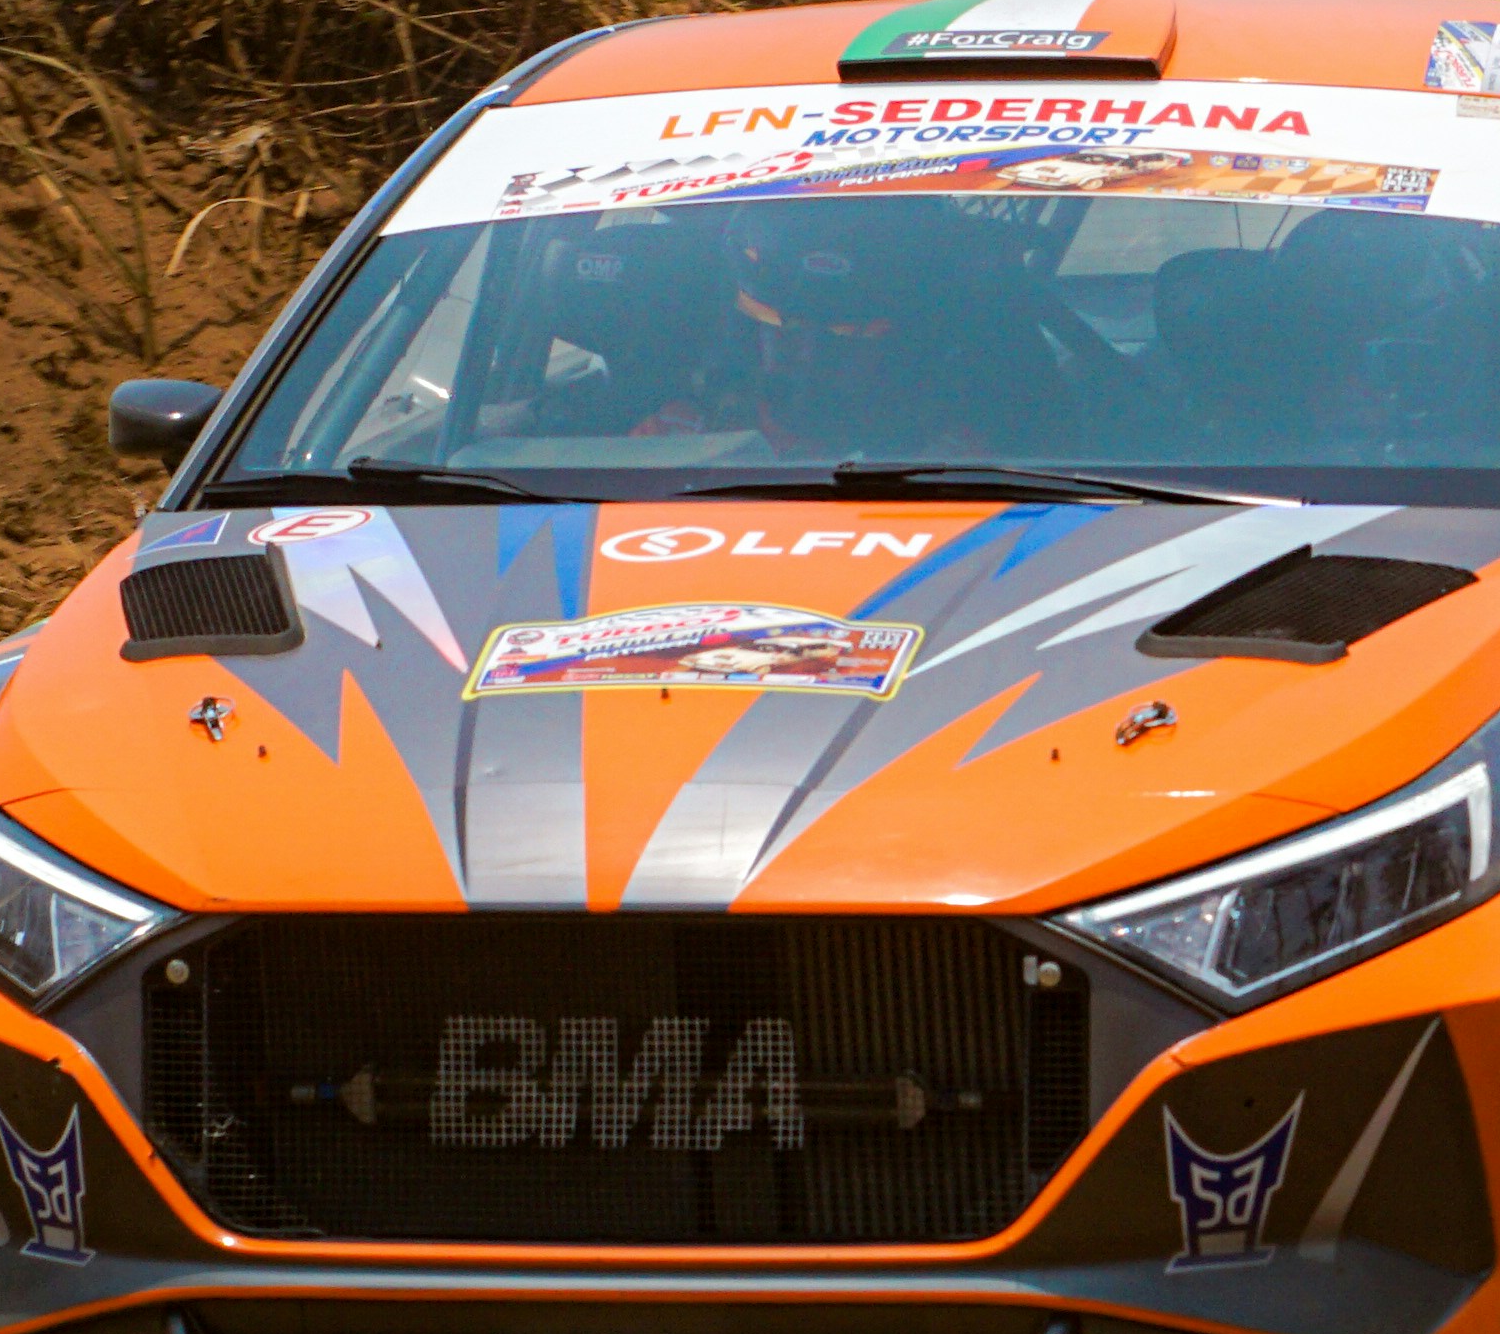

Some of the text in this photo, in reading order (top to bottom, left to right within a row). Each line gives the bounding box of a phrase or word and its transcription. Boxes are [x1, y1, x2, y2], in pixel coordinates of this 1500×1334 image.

[906, 30, 1092, 52] #ForCraig
[658, 98, 1312, 141] LFN-SEDERHANA
[802, 124, 1156, 148] MOTORSPORT
[729, 530, 936, 558] LFN
[429, 1016, 803, 1151] BMA
